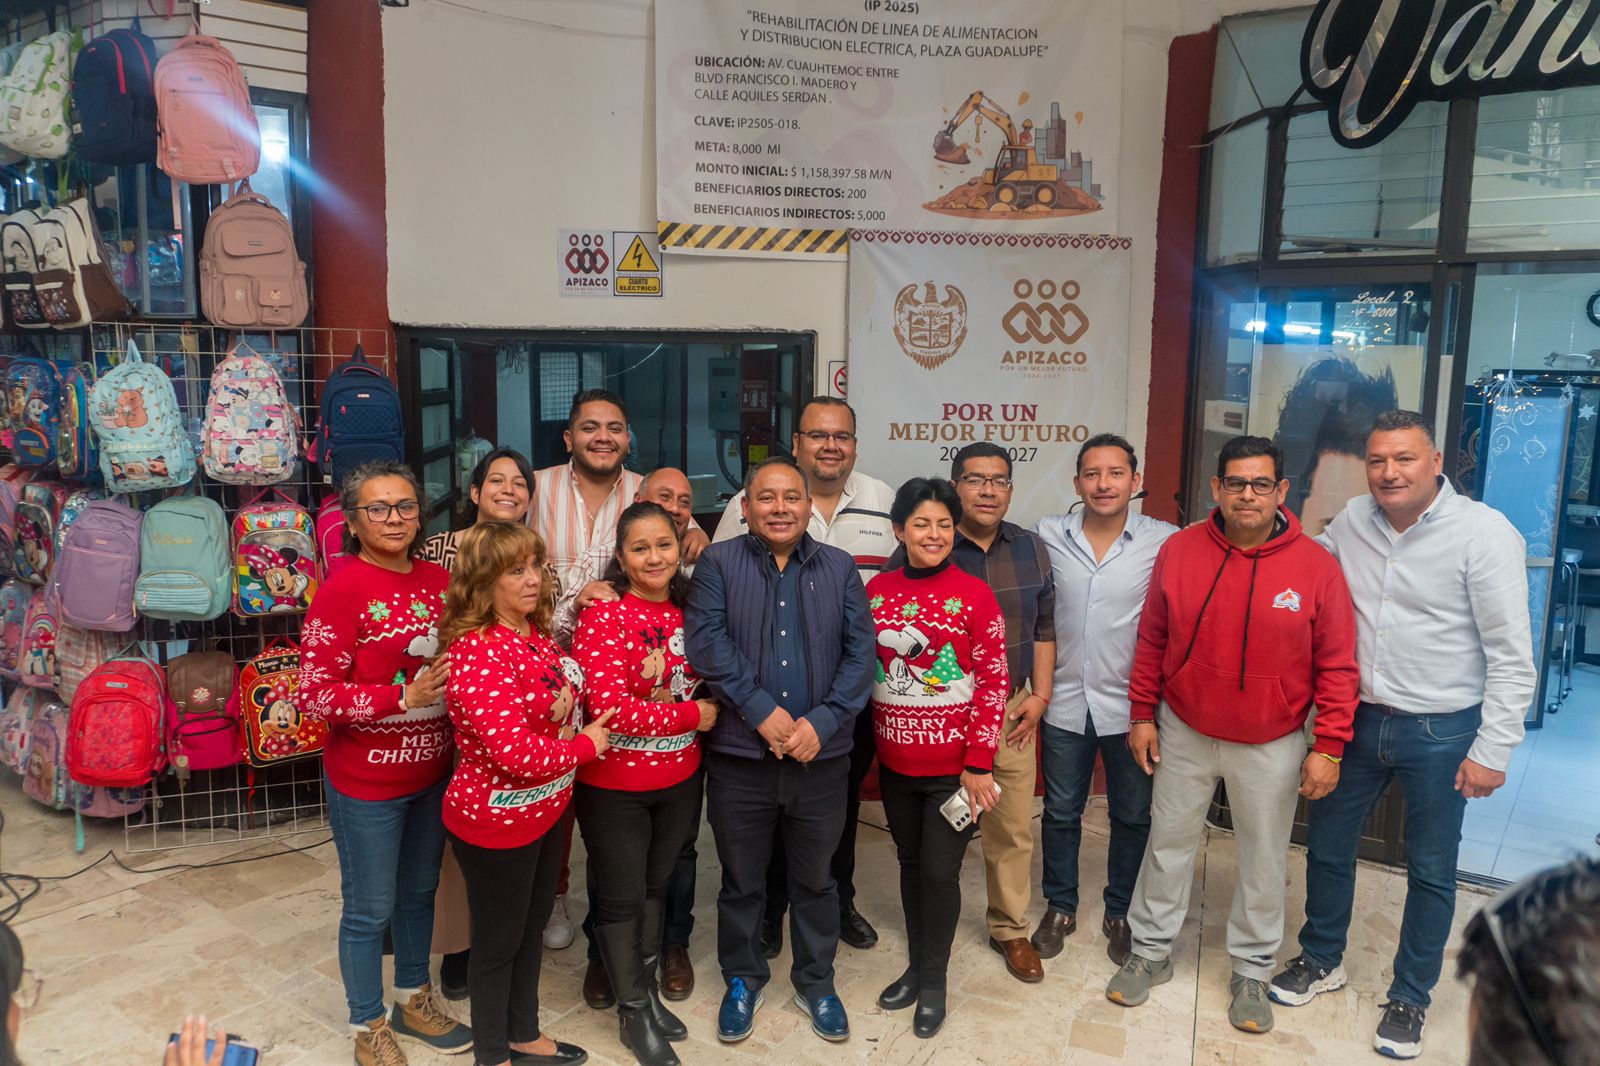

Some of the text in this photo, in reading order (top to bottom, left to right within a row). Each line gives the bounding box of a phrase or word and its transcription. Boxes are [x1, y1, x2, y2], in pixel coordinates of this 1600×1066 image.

[864, 0, 919, 14] (IP 2025)
[862, 22, 879, 35] DE
[883, 23, 919, 37] LINEA
[923, 25, 939, 38] DE
[943, 26, 1038, 40] ALIMENTACION
[740, 29, 749, 41] Y
[752, 29, 842, 52] DISTRIBUCION
[846, 41, 917, 57] ELECTRICA,
[920, 44, 962, 57] PLAZA
[695, 55, 900, 78] UBICACIÓN: AV. CUAUHTEMOC ENTRE
[694, 72, 857, 91] BLVD FRANCISCO I. MADERO Y
[694, 89, 729, 101] CALLE
[731, 90, 779, 103] AQUILES
[694, 115, 800, 129] CLAVE: IP2505-018.
[694, 141, 730, 153] META:
[732, 143, 762, 155] 8,000
[695, 162, 892, 180] MONTO INICIAL: $ 1,158,397.58 M/N
[694, 182, 867, 199] BENEFICIARIOS DIRECTOS: 200
[693, 204, 886, 222] BENEFICIARIOS INDIRECTOS: 5,000
[566, 278, 608, 287] APIZACO
[1352, 290, 1414, 304] Local 2
[1001, 350, 1088, 365] APIZACO
[942, 402, 1039, 422] POR UN
[888, 422, 1090, 444] MEJOR FUTURO
[257, 660, 280, 669] Minnie
[885, 715, 946, 731] MERRY
[608, 730, 697, 750] ERRY CHRIS
[367, 742, 448, 764] CHRIST
[491, 779, 560, 806] MERRY
